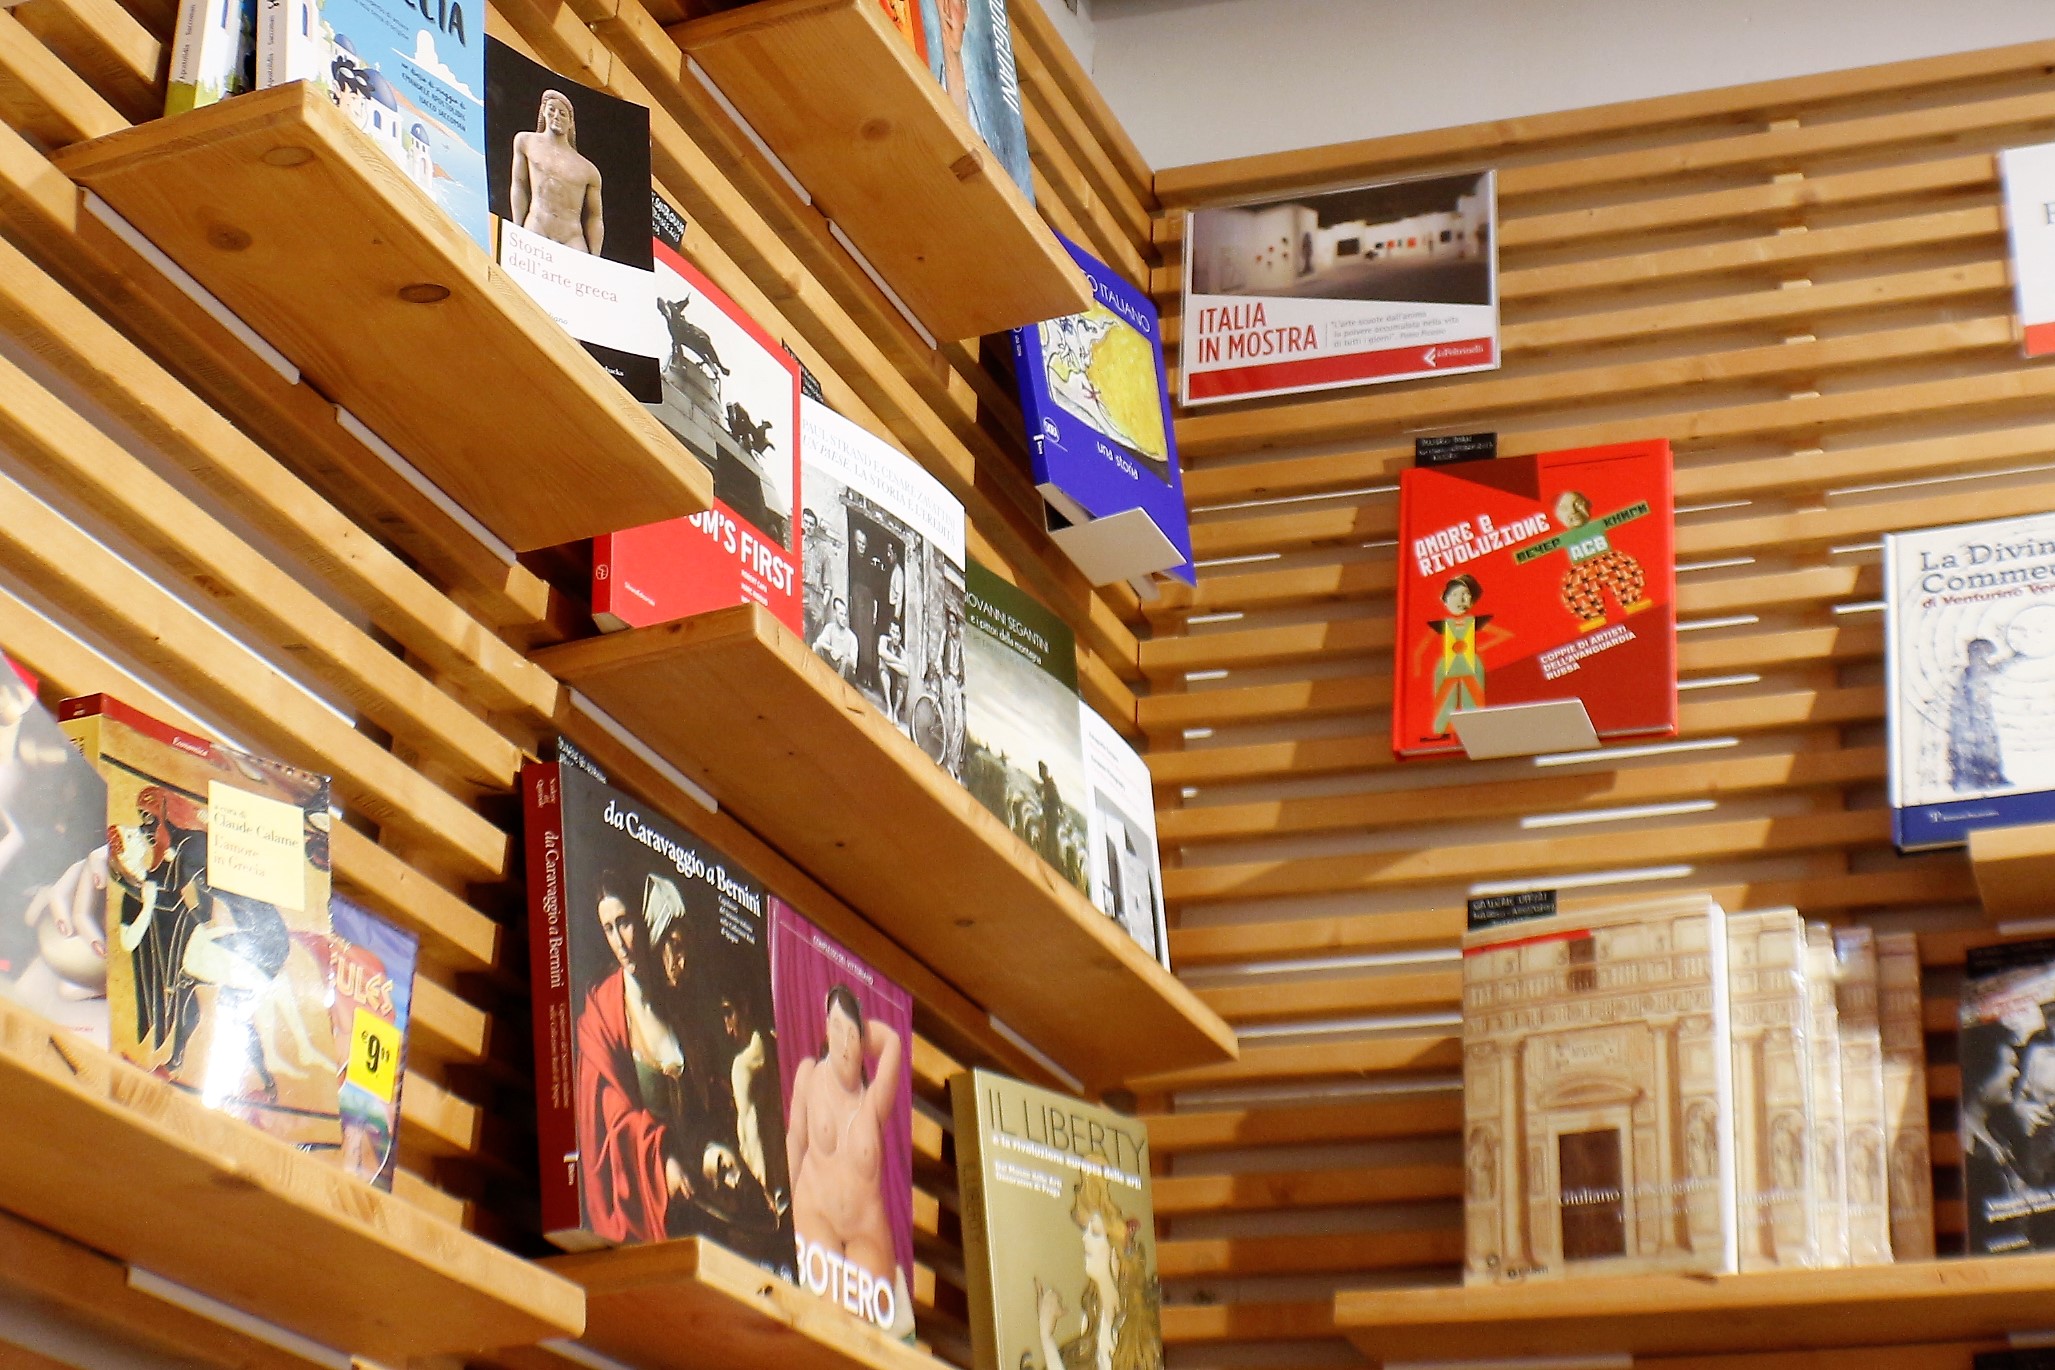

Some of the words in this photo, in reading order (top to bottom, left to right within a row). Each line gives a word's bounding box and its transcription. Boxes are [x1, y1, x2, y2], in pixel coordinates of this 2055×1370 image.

[509, 232, 554, 263] Storia
[509, 252, 572, 289] dell'arte
[575, 281, 618, 305] greca
[1099, 283, 1150, 333] ITALIANO
[1200, 303, 1267, 334] ITALIA
[1198, 339, 1221, 363] IN
[1228, 325, 1318, 359] MOSTRA
[1097, 441, 1113, 461] una
[1115, 455, 1139, 481] storia
[1415, 521, 1474, 559] AMORE
[1418, 512, 1550, 577] RIVOLUZIONE
[741, 530, 795, 597] FIRST
[1920, 552, 1959, 572] La
[965, 591, 1006, 625] IOVANNI
[1540, 645, 1576, 664] COPPIE
[1578, 638, 1589, 649] DI
[1591, 625, 1627, 645] ARTISTI
[214, 813, 252, 833] Claude
[256, 825, 299, 846] Calame
[214, 834, 259, 856] L'amore
[545, 831, 559, 848] da
[214, 852, 225, 865] in
[228, 856, 265, 877] Grecia
[604, 801, 625, 832] da
[626, 811, 704, 878] Caravaggio
[706, 867, 716, 887] a
[717, 867, 761, 918] Bernini
[542, 848, 561, 925] Caravaggio
[549, 935, 564, 989] Bernini
[330, 952, 393, 1017] ULES
[989, 1088, 1016, 1135] IL
[1024, 1100, 1145, 1174] LIBERTY
